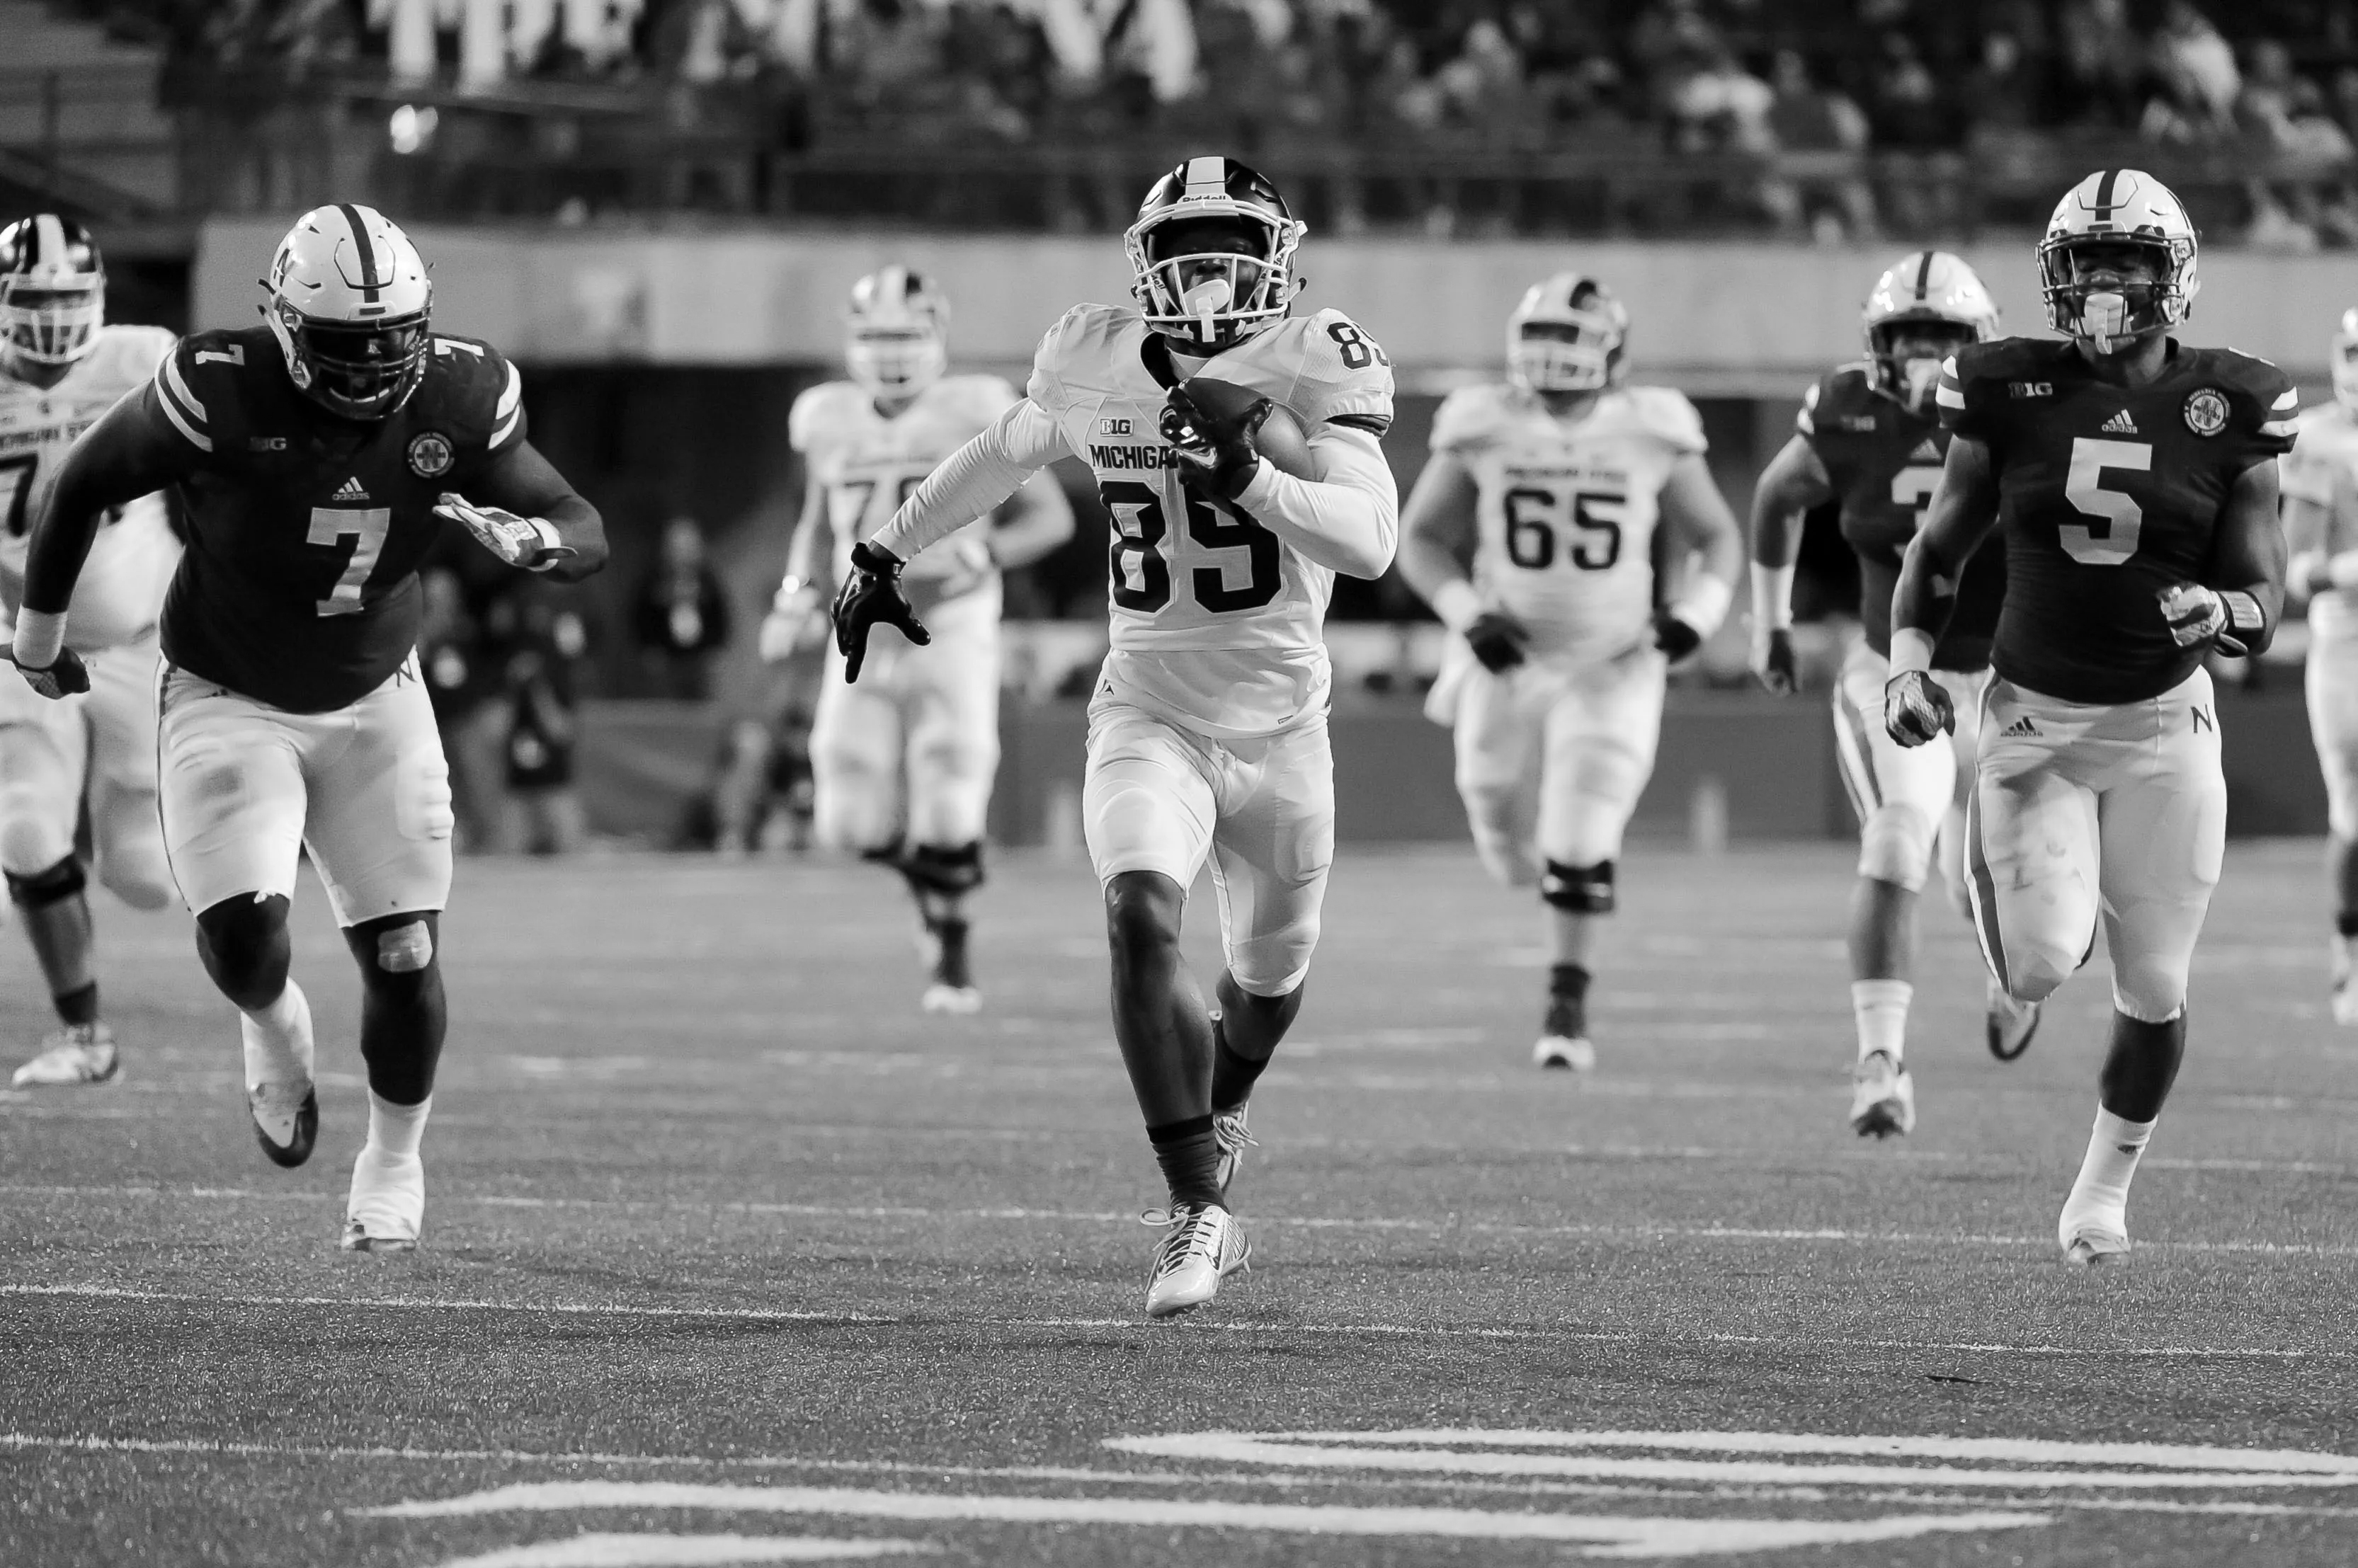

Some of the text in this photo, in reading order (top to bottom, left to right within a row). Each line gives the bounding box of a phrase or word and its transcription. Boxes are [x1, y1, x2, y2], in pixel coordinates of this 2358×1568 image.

[195, 344, 245, 366] 7
[434, 338, 484, 357] 7
[1088, 444, 1179, 469] MICHIGA
[843, 476, 930, 542] 7
[2058, 437, 2153, 565] 5
[1505, 489, 1627, 570] 65
[306, 507, 391, 617] 7
[2190, 704, 2212, 733] N
